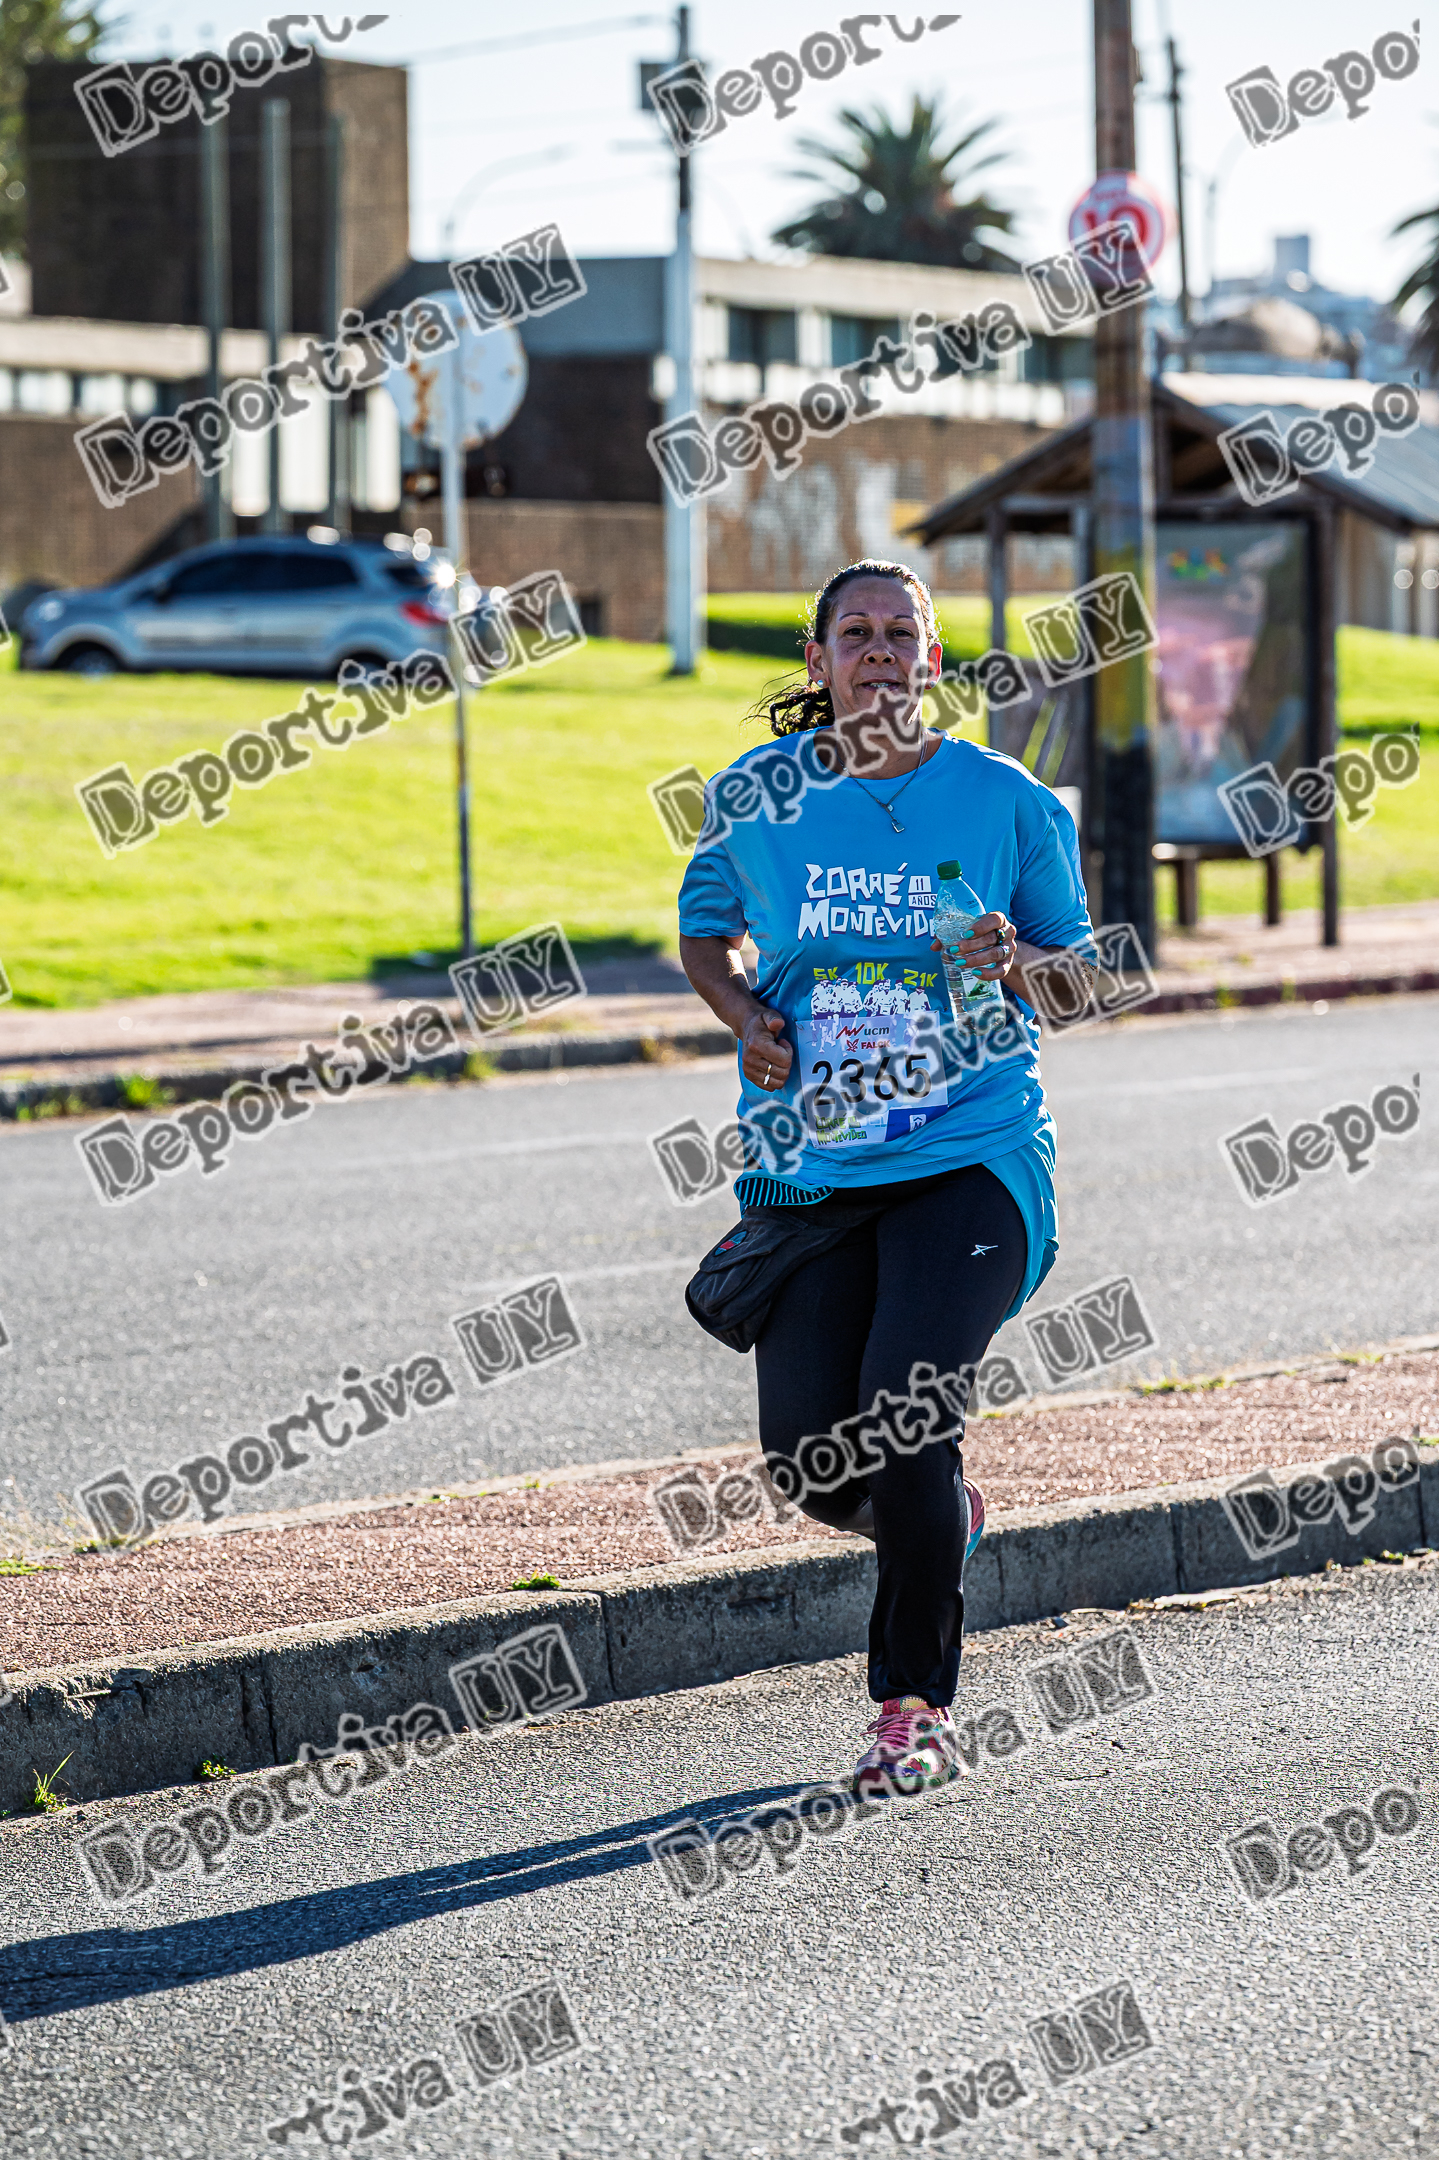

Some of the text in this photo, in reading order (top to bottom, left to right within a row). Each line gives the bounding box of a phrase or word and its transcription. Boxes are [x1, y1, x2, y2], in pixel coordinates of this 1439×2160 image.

[915, 878, 924, 890] 11
[911, 895, 937, 907] AÑOS
[798, 898, 936, 941] MONTEVID
[813, 962, 938, 987] 5K 10K 21K
[864, 1026, 890, 1036] ucm
[861, 1040, 891, 1049] FALCK
[811, 1053, 932, 1106] 2365
